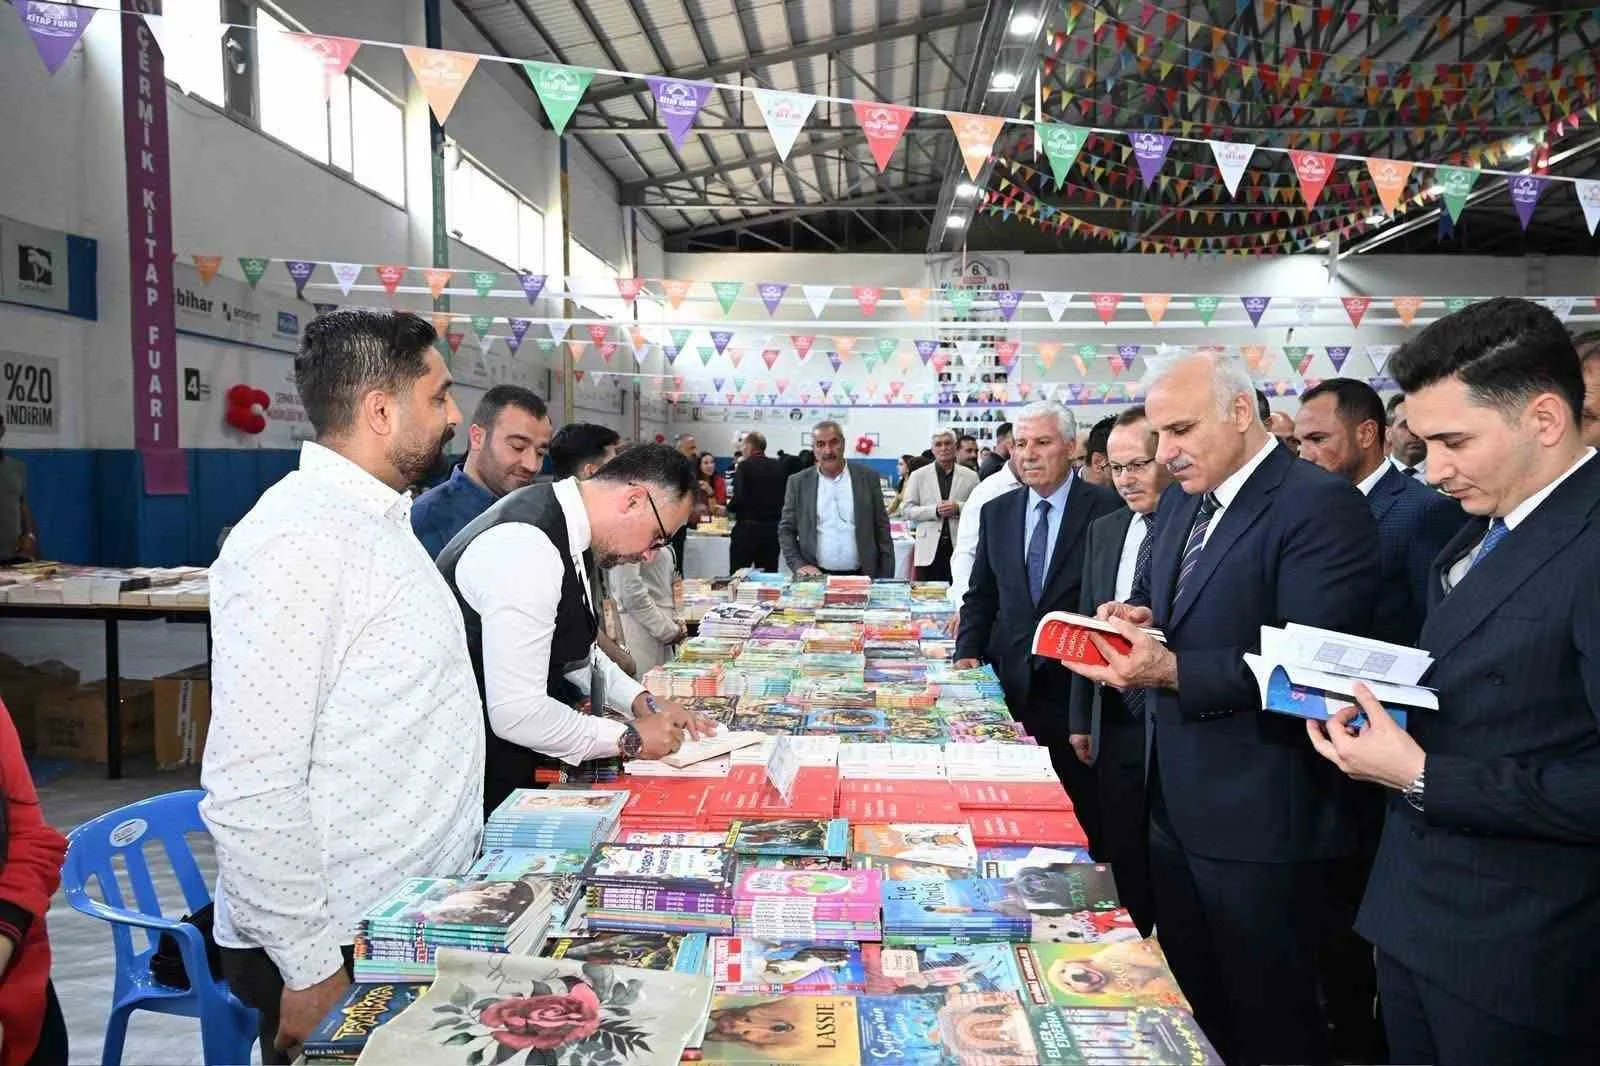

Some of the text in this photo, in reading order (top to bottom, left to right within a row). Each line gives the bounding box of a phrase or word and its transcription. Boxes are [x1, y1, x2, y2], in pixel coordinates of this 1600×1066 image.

[27, 13, 51, 25] KİTAP
[143, 187, 160, 306] KİTAP
[4, 362, 52, 404] %20
[147, 326, 163, 441] FUARI
[816, 1003, 836, 1048] LASSIE
[1040, 1030, 1061, 1059] ELMER
